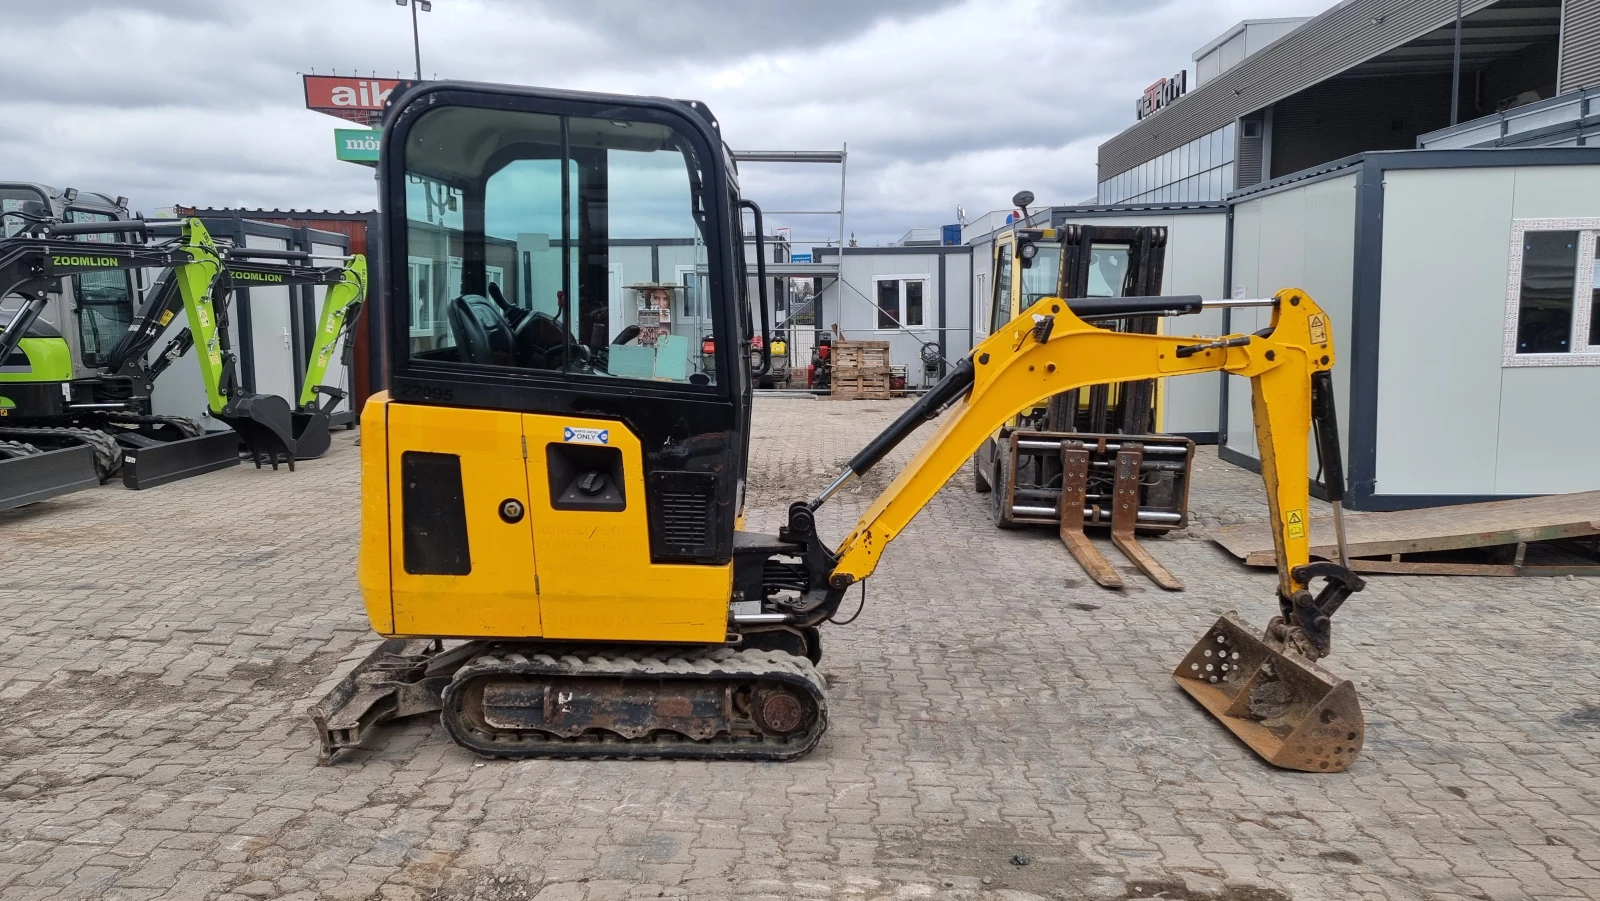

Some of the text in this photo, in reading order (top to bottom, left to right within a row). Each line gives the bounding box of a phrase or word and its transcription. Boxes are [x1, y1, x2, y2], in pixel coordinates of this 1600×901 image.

[345, 136, 381, 151] mö
[52, 256, 119, 267] ZOOMLION
[229, 270, 282, 283] ZOOMLION
[400, 383, 454, 401] 22095
